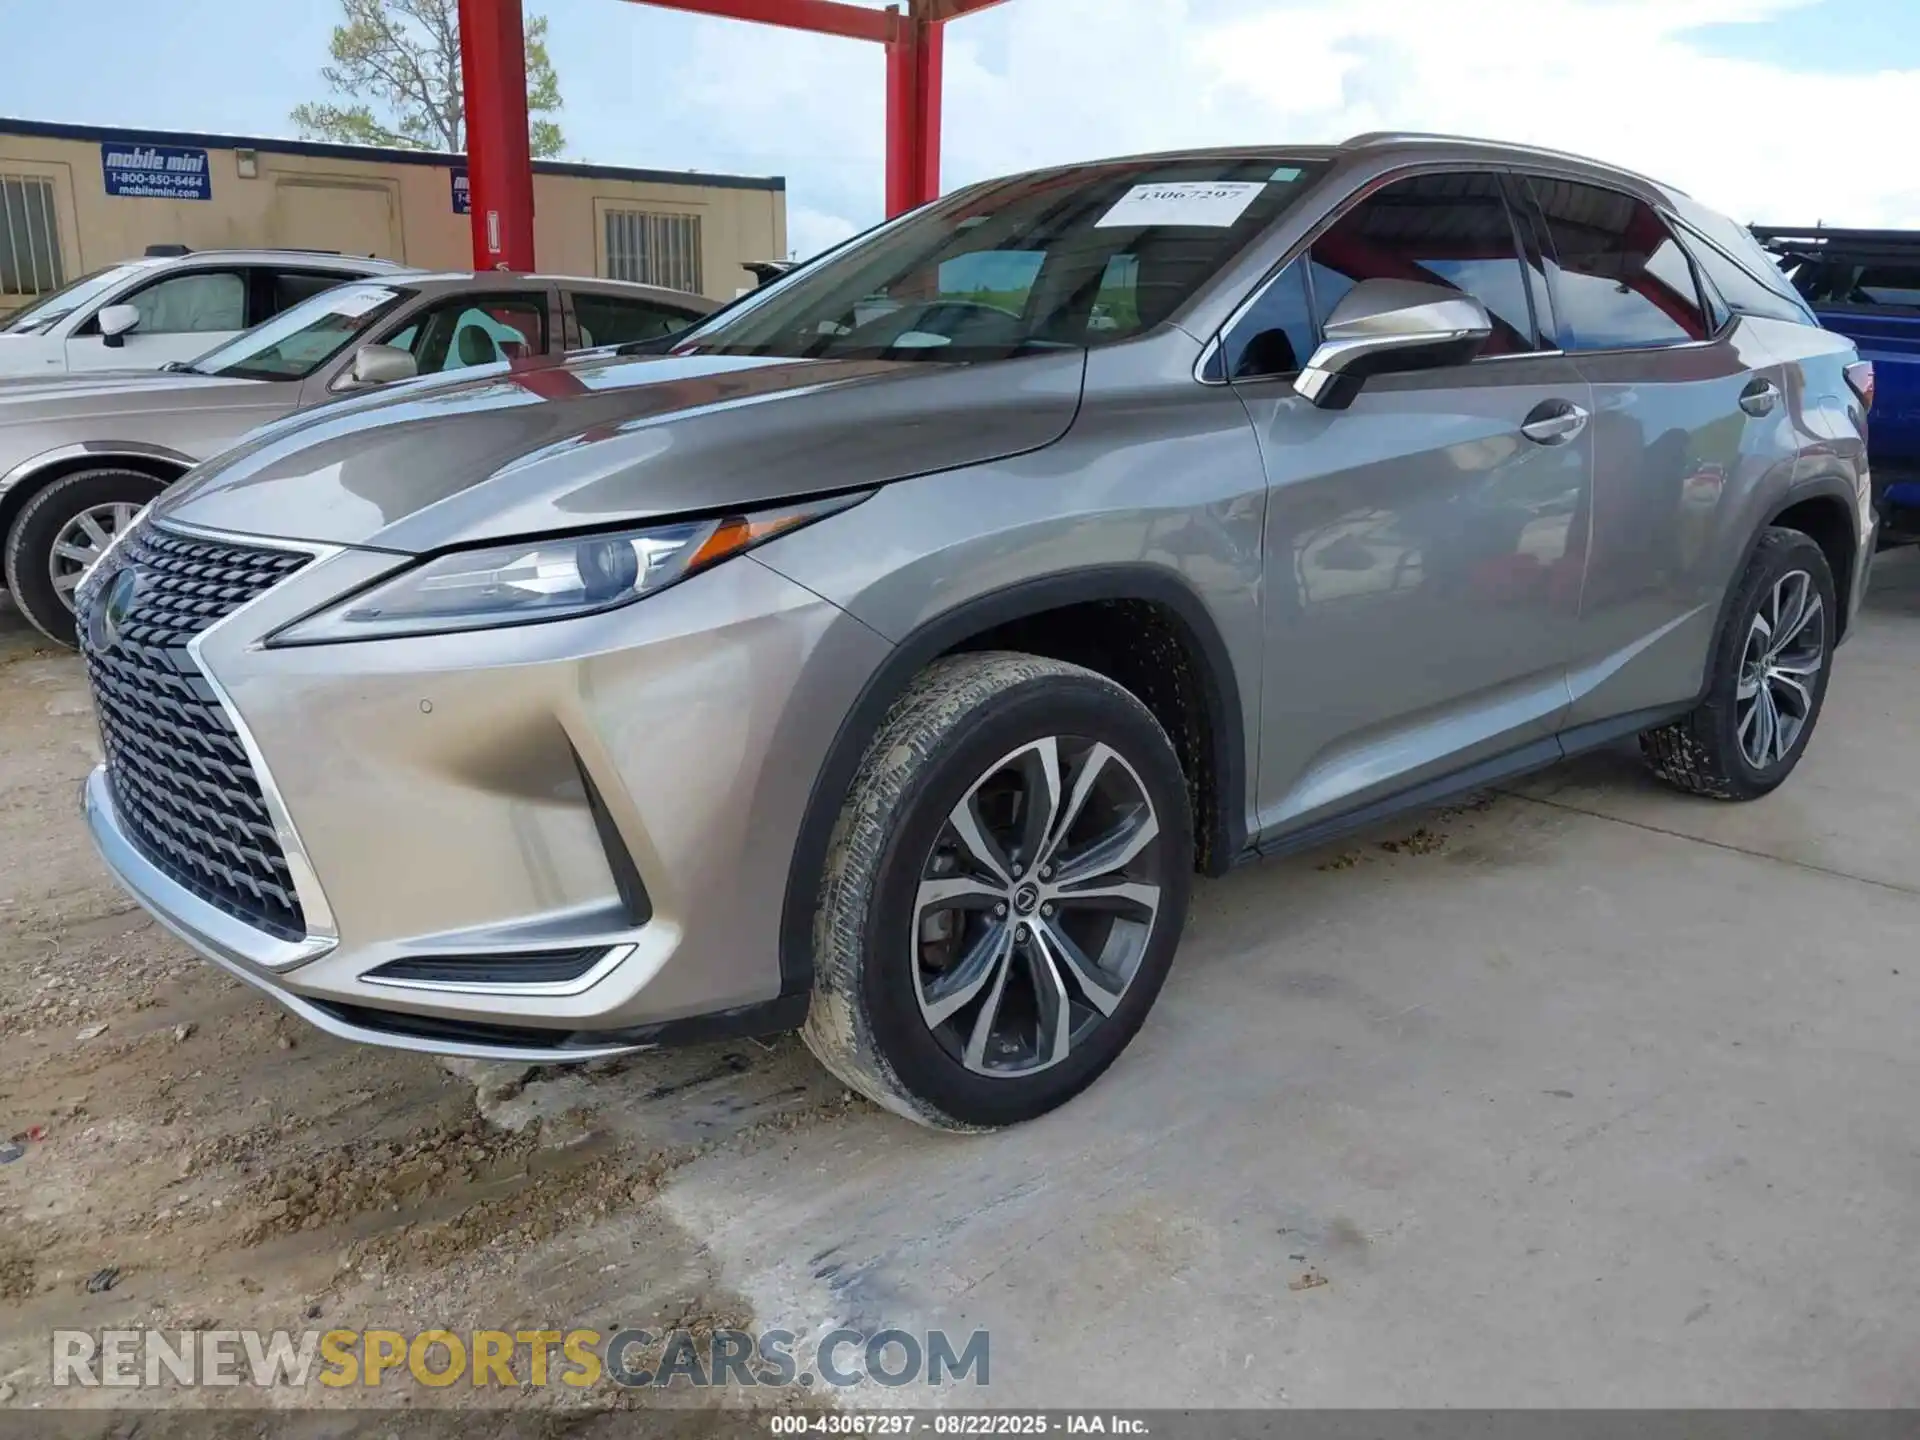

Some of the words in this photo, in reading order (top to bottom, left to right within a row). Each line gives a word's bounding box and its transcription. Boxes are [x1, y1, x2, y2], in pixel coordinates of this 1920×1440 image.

[106, 147, 164, 169] mobile
[166, 153, 205, 172] mini
[119, 185, 199, 198] mobilemini.com
